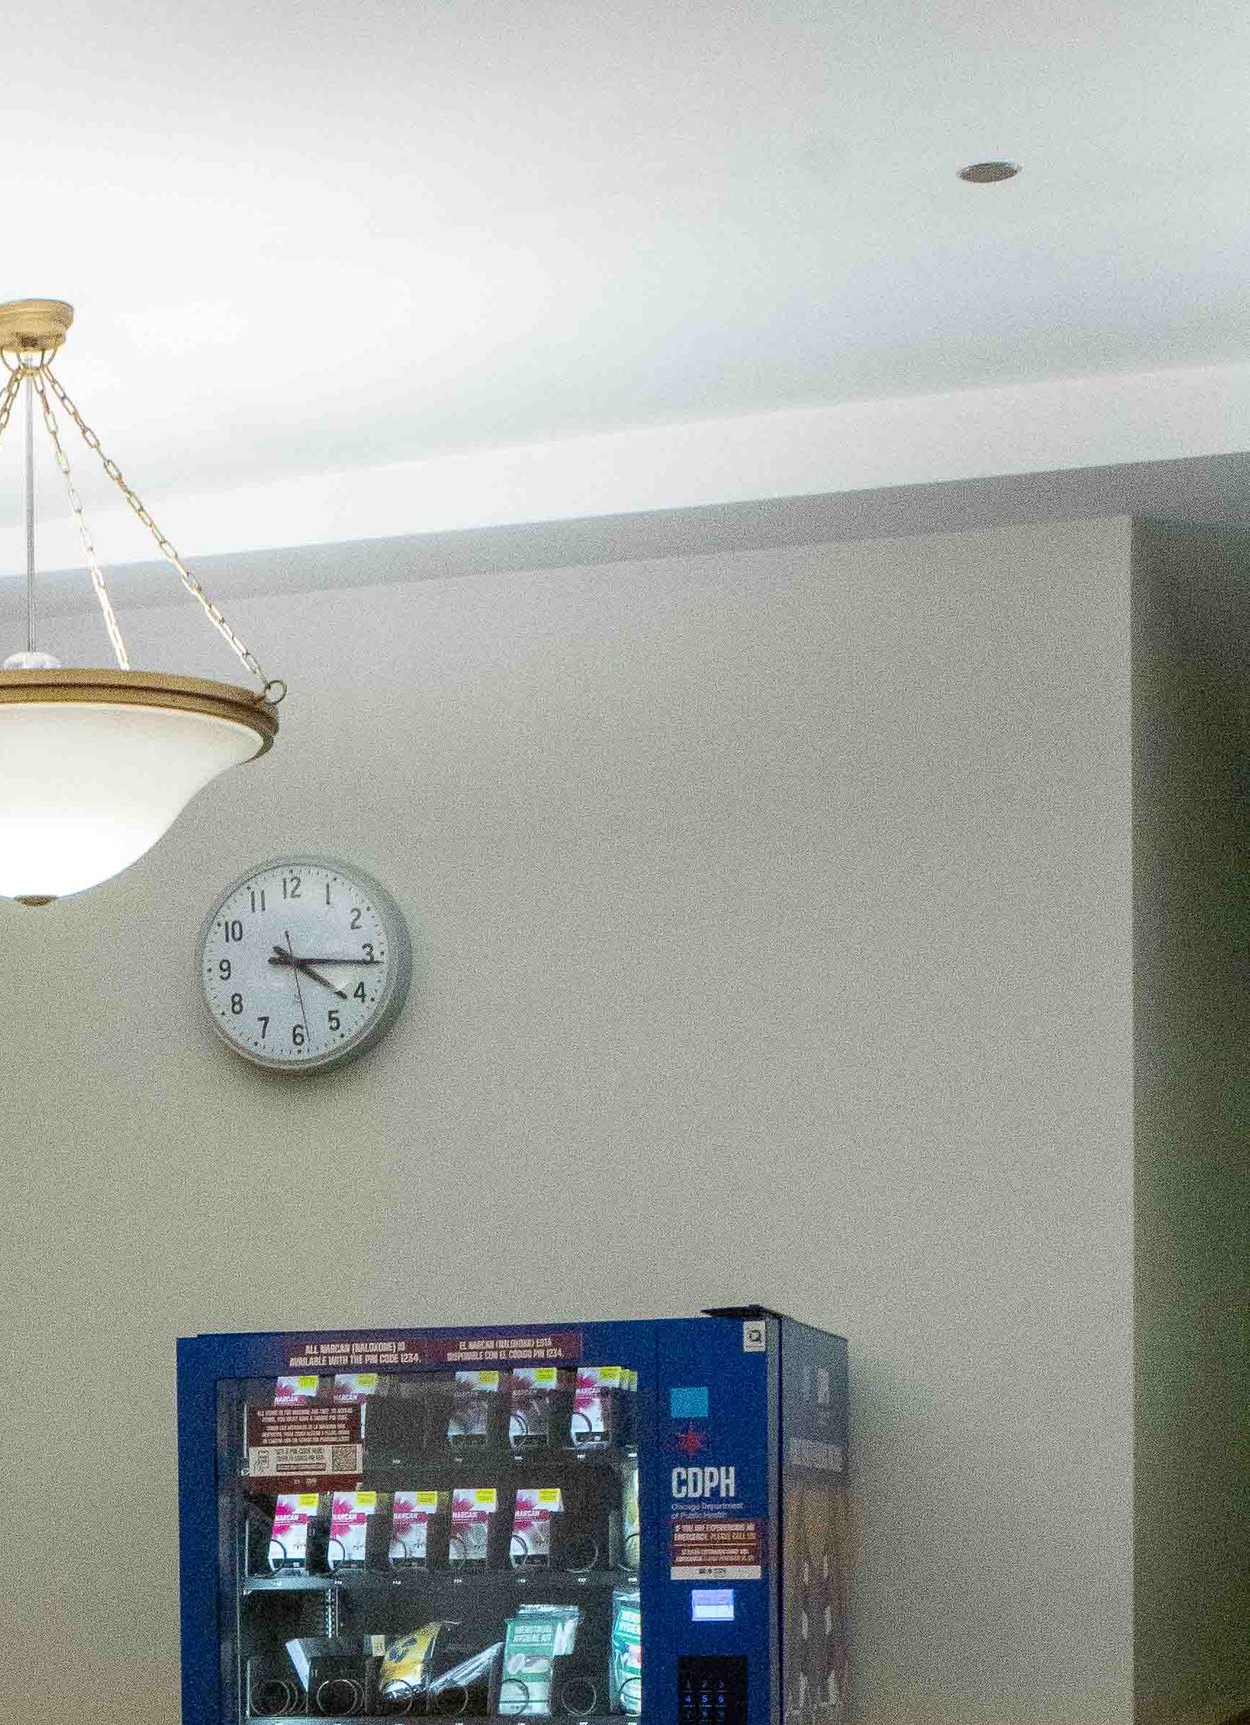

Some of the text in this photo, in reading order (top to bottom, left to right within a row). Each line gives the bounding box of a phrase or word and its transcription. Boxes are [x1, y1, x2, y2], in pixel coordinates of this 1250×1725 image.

[282, 876, 301, 899] 12
[325, 882, 331, 905] 1
[251, 890, 266, 913] 11
[350, 908, 362, 930] 2
[225, 920, 243, 942] 10
[362, 943, 374, 963] 3
[219, 959, 232, 981] 9
[353, 982, 366, 1003] 4
[231, 993, 243, 1015] 8
[257, 1016, 269, 1039] 7
[328, 1010, 340, 1031] 5
[293, 1025, 304, 1046] 6
[305, 1345, 318, 1354] ALL
[320, 1343, 350, 1354] NARCAN
[289, 1356, 327, 1367] AVAILABLE
[328, 1355, 348, 1366] WITH
[350, 1354, 363, 1364] THE
[365, 1354, 378, 1364] PIN
[379, 1353, 399, 1364] CODE
[672, 1466, 735, 1498] CDPH
[275, 1514, 300, 1522] NARCAN
